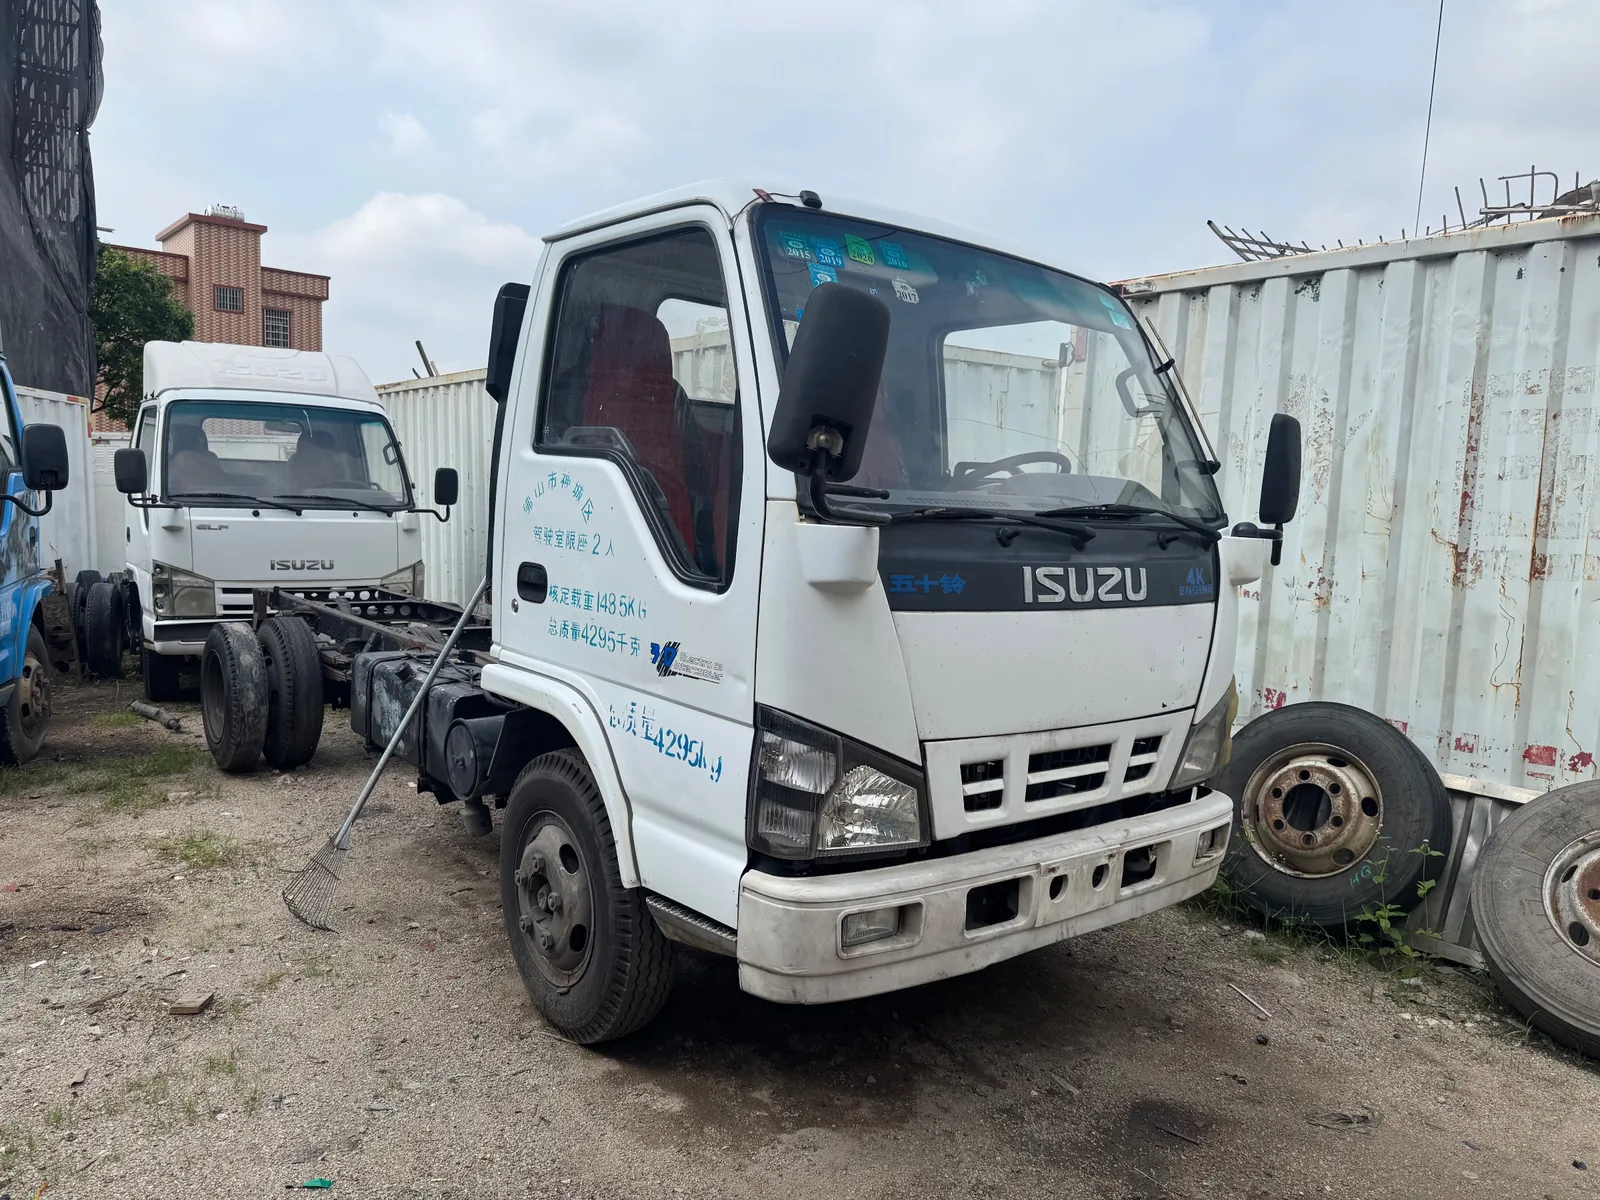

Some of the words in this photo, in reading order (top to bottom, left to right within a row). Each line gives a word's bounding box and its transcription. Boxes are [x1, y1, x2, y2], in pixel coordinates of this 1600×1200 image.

[786, 247, 811, 260] 2015
[852, 253, 874, 265] 2020
[819, 254, 842, 267] 2019
[896, 290, 917, 304] 2017
[270, 559, 335, 571] ISUZU
[1185, 567, 1206, 585] 4K
[889, 573, 966, 595] 五十铃
[1022, 566, 1148, 603] ISUZU
[1179, 584, 1213, 596] ENGINE
